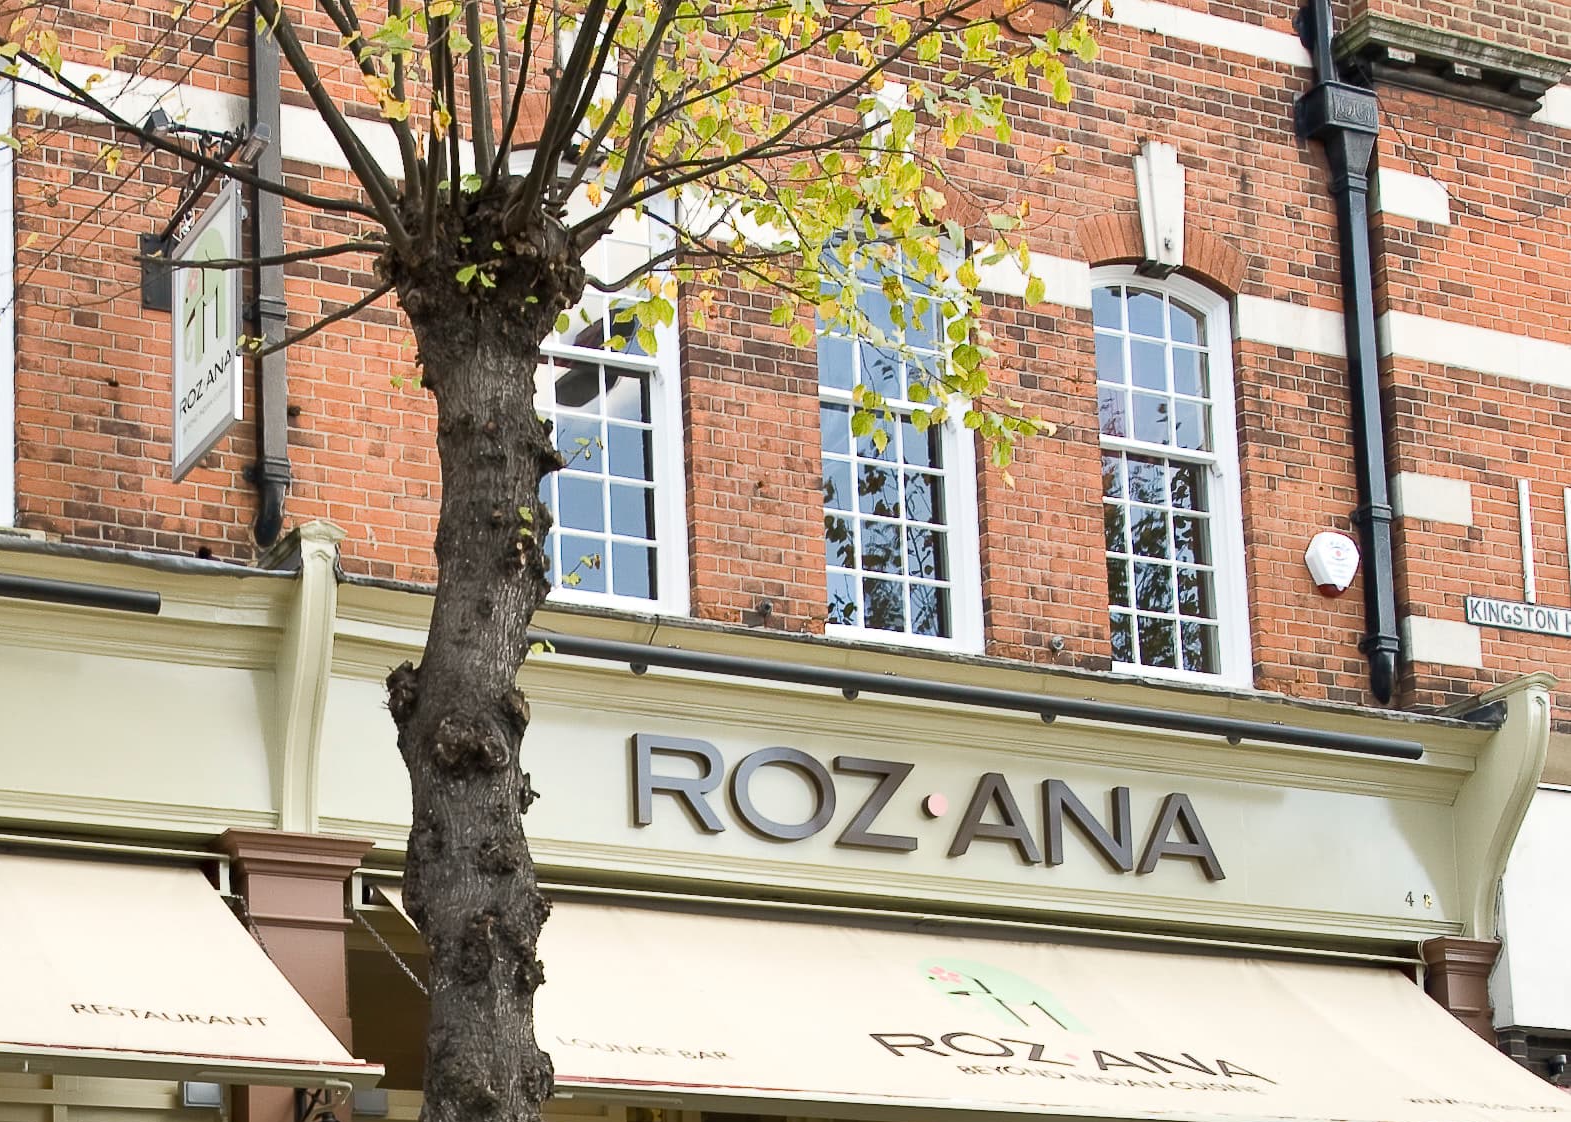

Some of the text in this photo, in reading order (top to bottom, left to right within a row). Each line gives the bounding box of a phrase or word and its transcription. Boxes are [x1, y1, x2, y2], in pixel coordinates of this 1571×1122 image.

[1470, 599, 1559, 632] KINGSTON
[70, 1003, 268, 1027] RESTAURANT
[555, 1035, 677, 1057] LOUNGE
[956, 1064, 1067, 1081] BEYOND
